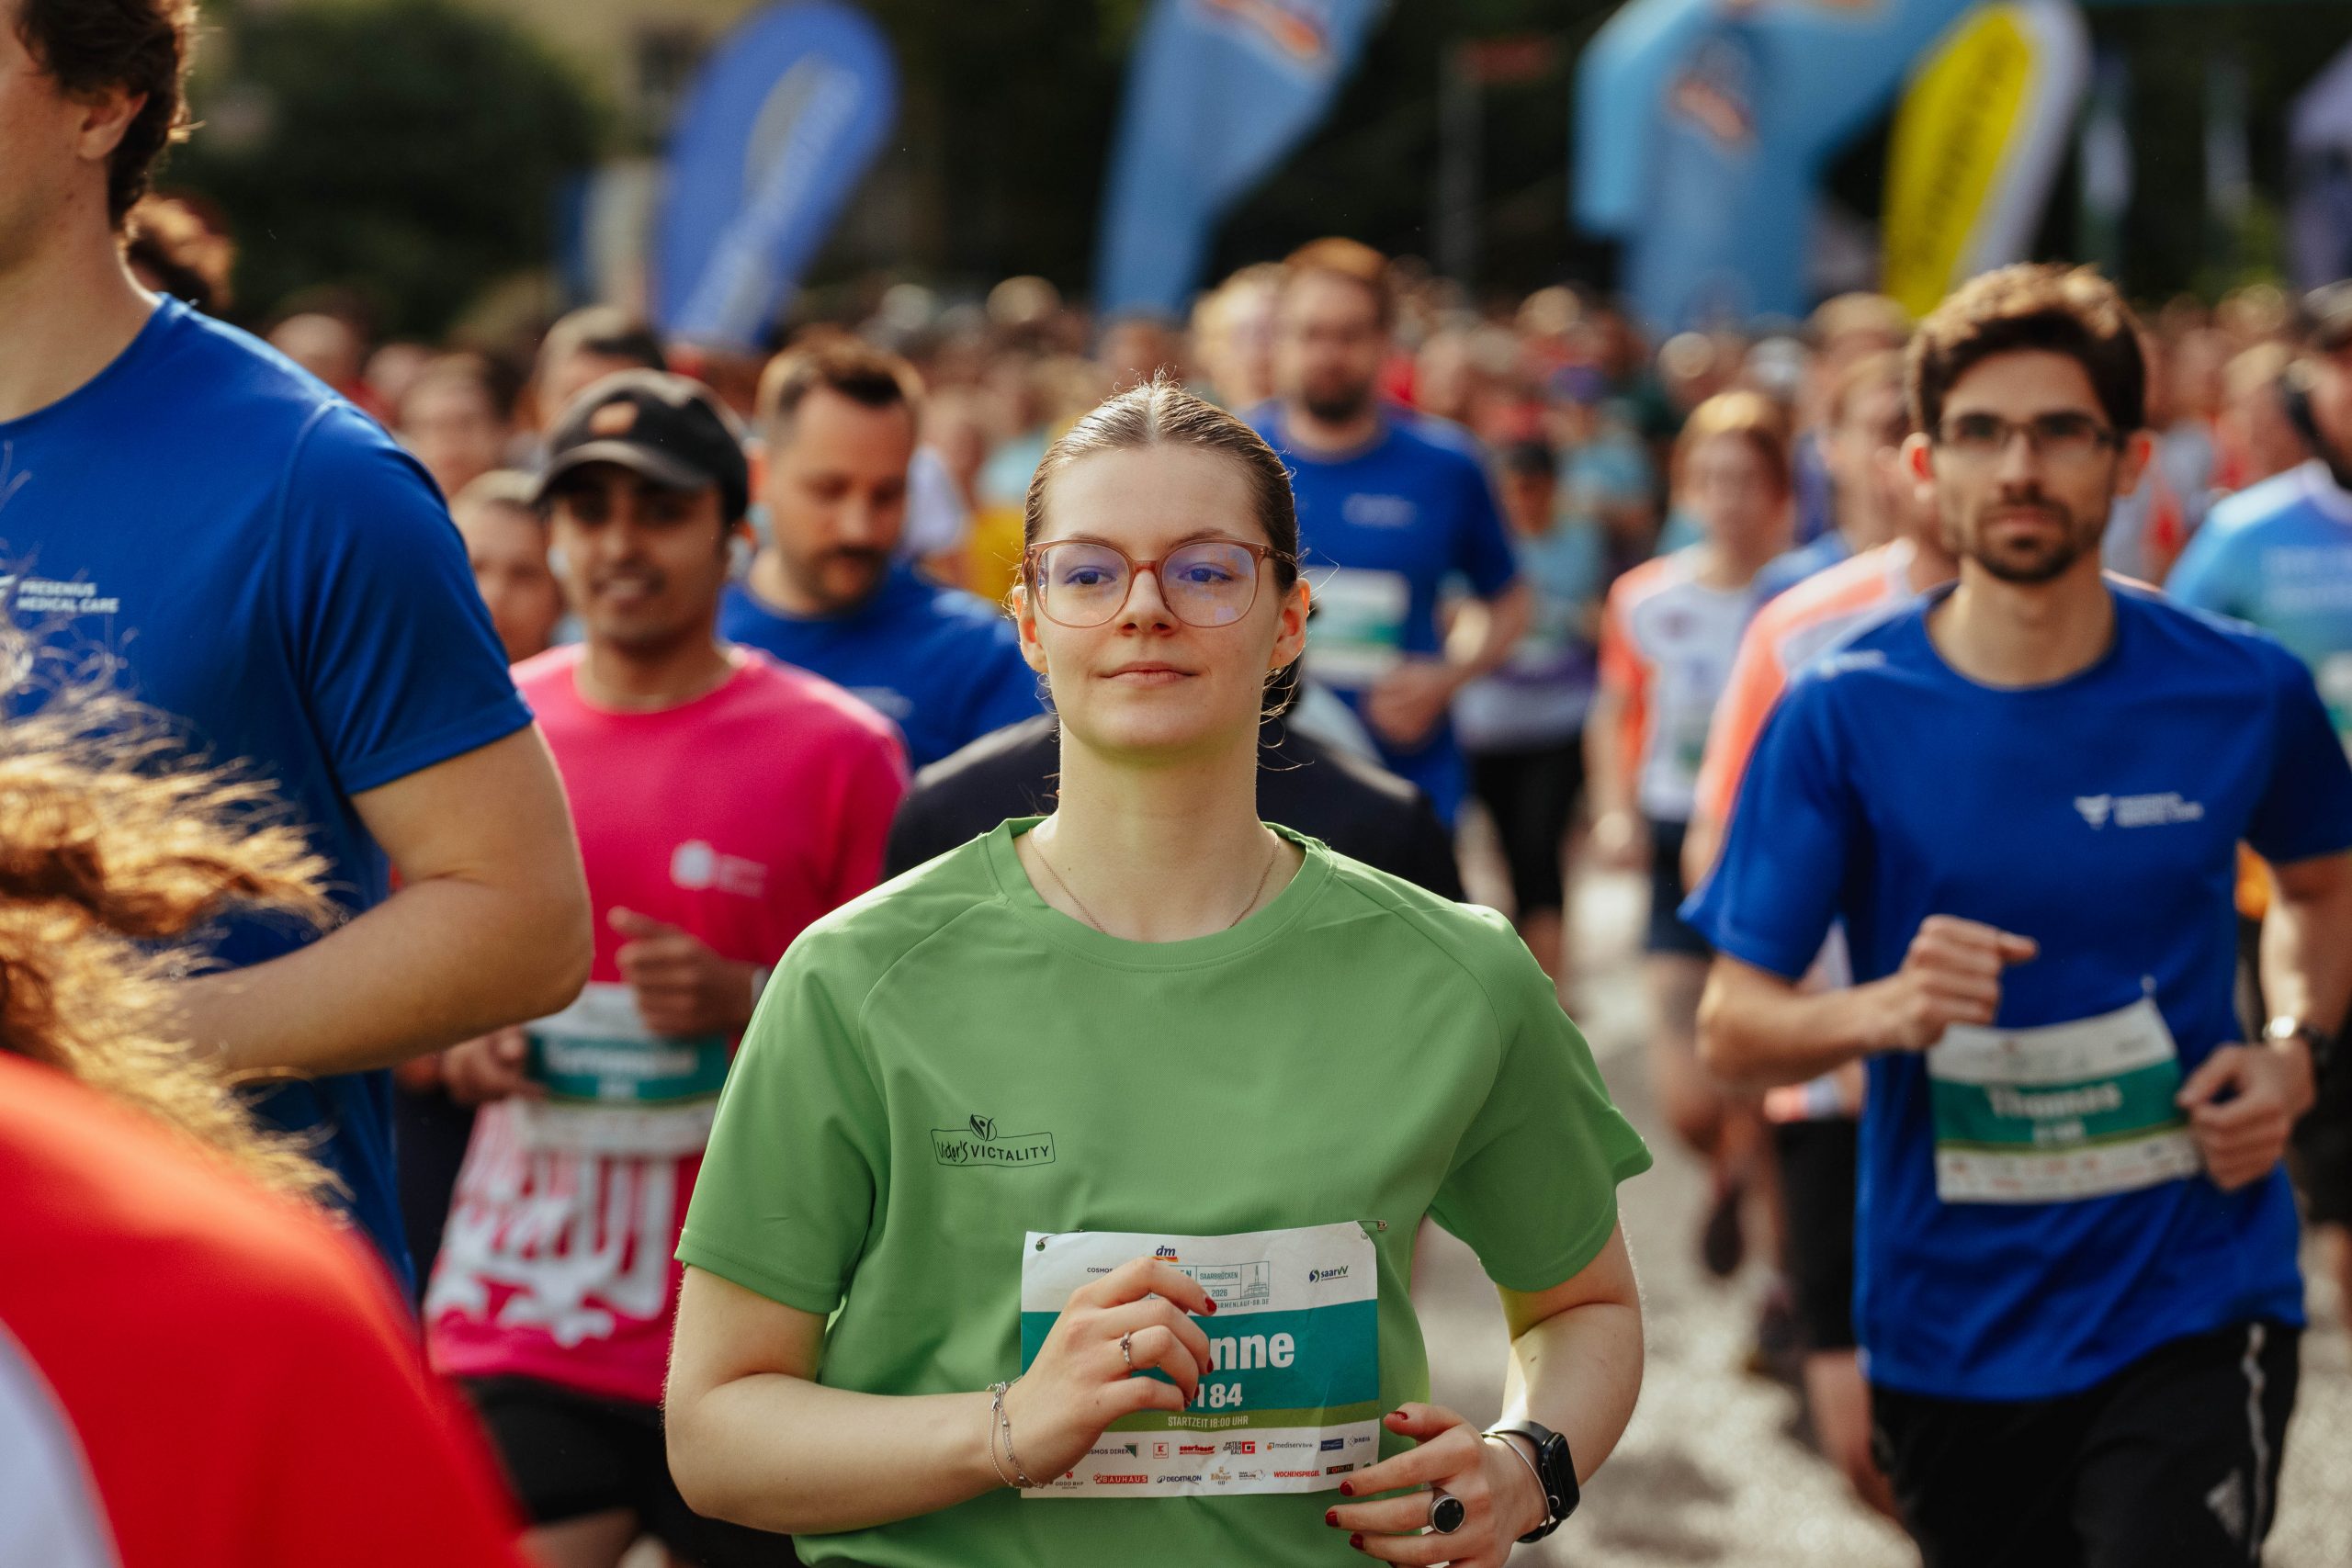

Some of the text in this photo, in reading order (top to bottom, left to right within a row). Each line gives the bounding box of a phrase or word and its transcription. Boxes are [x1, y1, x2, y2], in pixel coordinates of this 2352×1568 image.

[17, 596, 119, 614] MEDICAL CARE
[971, 1145, 1049, 1161] VICTALITY
[1156, 1246, 1176, 1257] dm
[1199, 1271, 1238, 1280] SAARBRÜCKEN
[1211, 1289, 1228, 1297] 2026
[1217, 1298, 1270, 1309] IRMENLAUF-SB.DE
[1210, 1332, 1295, 1371] nne
[1197, 1382, 1243, 1408] 184
[1168, 1415, 1249, 1428] STARTZEIT 18:00 UHR
[1102, 1474, 1148, 1483] BAUHAUS
[1166, 1474, 1202, 1483] DECATHLON
[1273, 1470, 1320, 1478] WOCHENSPIEGEL
